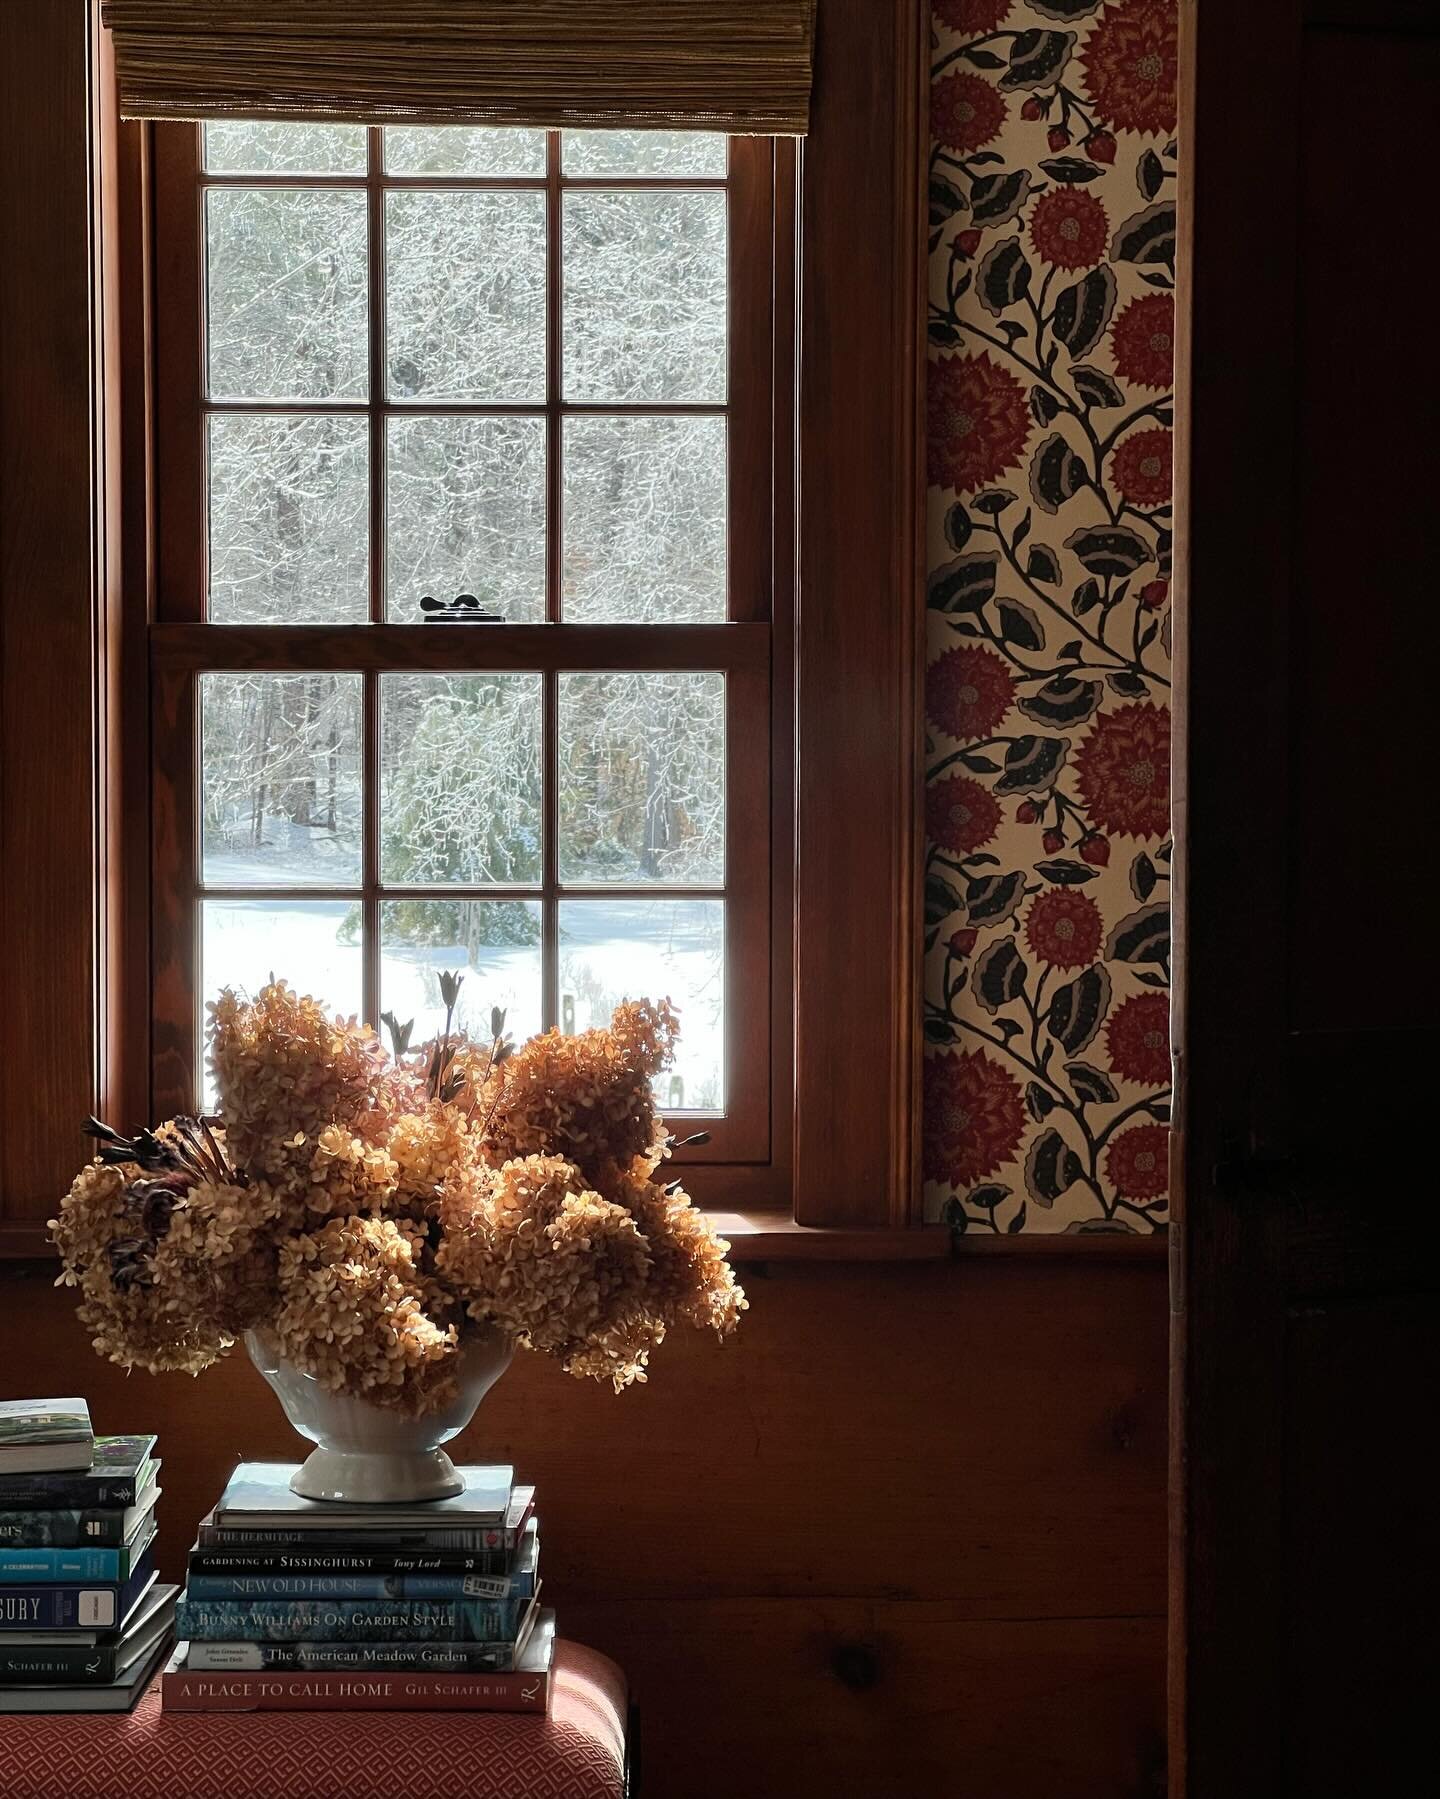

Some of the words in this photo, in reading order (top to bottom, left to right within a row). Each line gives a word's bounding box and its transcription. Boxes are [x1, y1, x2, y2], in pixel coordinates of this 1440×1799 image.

[216, 1532, 238, 1541] THE
[240, 1532, 305, 1541] HERMITAGE
[202, 1558, 259, 1566] GARDENING
[263, 1558, 275, 1566] AT
[280, 1556, 374, 1568] SISSINGHURST
[393, 1559, 414, 1570] Tony
[417, 1559, 441, 1568] Lord
[232, 1579, 270, 1593] NEW
[272, 1579, 306, 1593] OLD
[309, 1579, 360, 1592] HOUSE
[199, 1613, 248, 1626] BUNNY
[252, 1613, 320, 1626] WILLIAMS
[352, 1613, 409, 1626] GARDEN
[413, 1613, 456, 1626] STYLE
[268, 1649, 293, 1661] The
[297, 1649, 359, 1661] American
[363, 1650, 417, 1662] Meadow
[421, 1650, 468, 1662] Garden
[180, 1684, 192, 1697] A
[198, 1684, 252, 1697] PLACE
[258, 1684, 283, 1697] TO
[289, 1684, 334, 1697] CALL
[339, 1684, 394, 1697] HOME
[405, 1684, 430, 1695] GIL
[434, 1684, 490, 1695] SCHAFER
